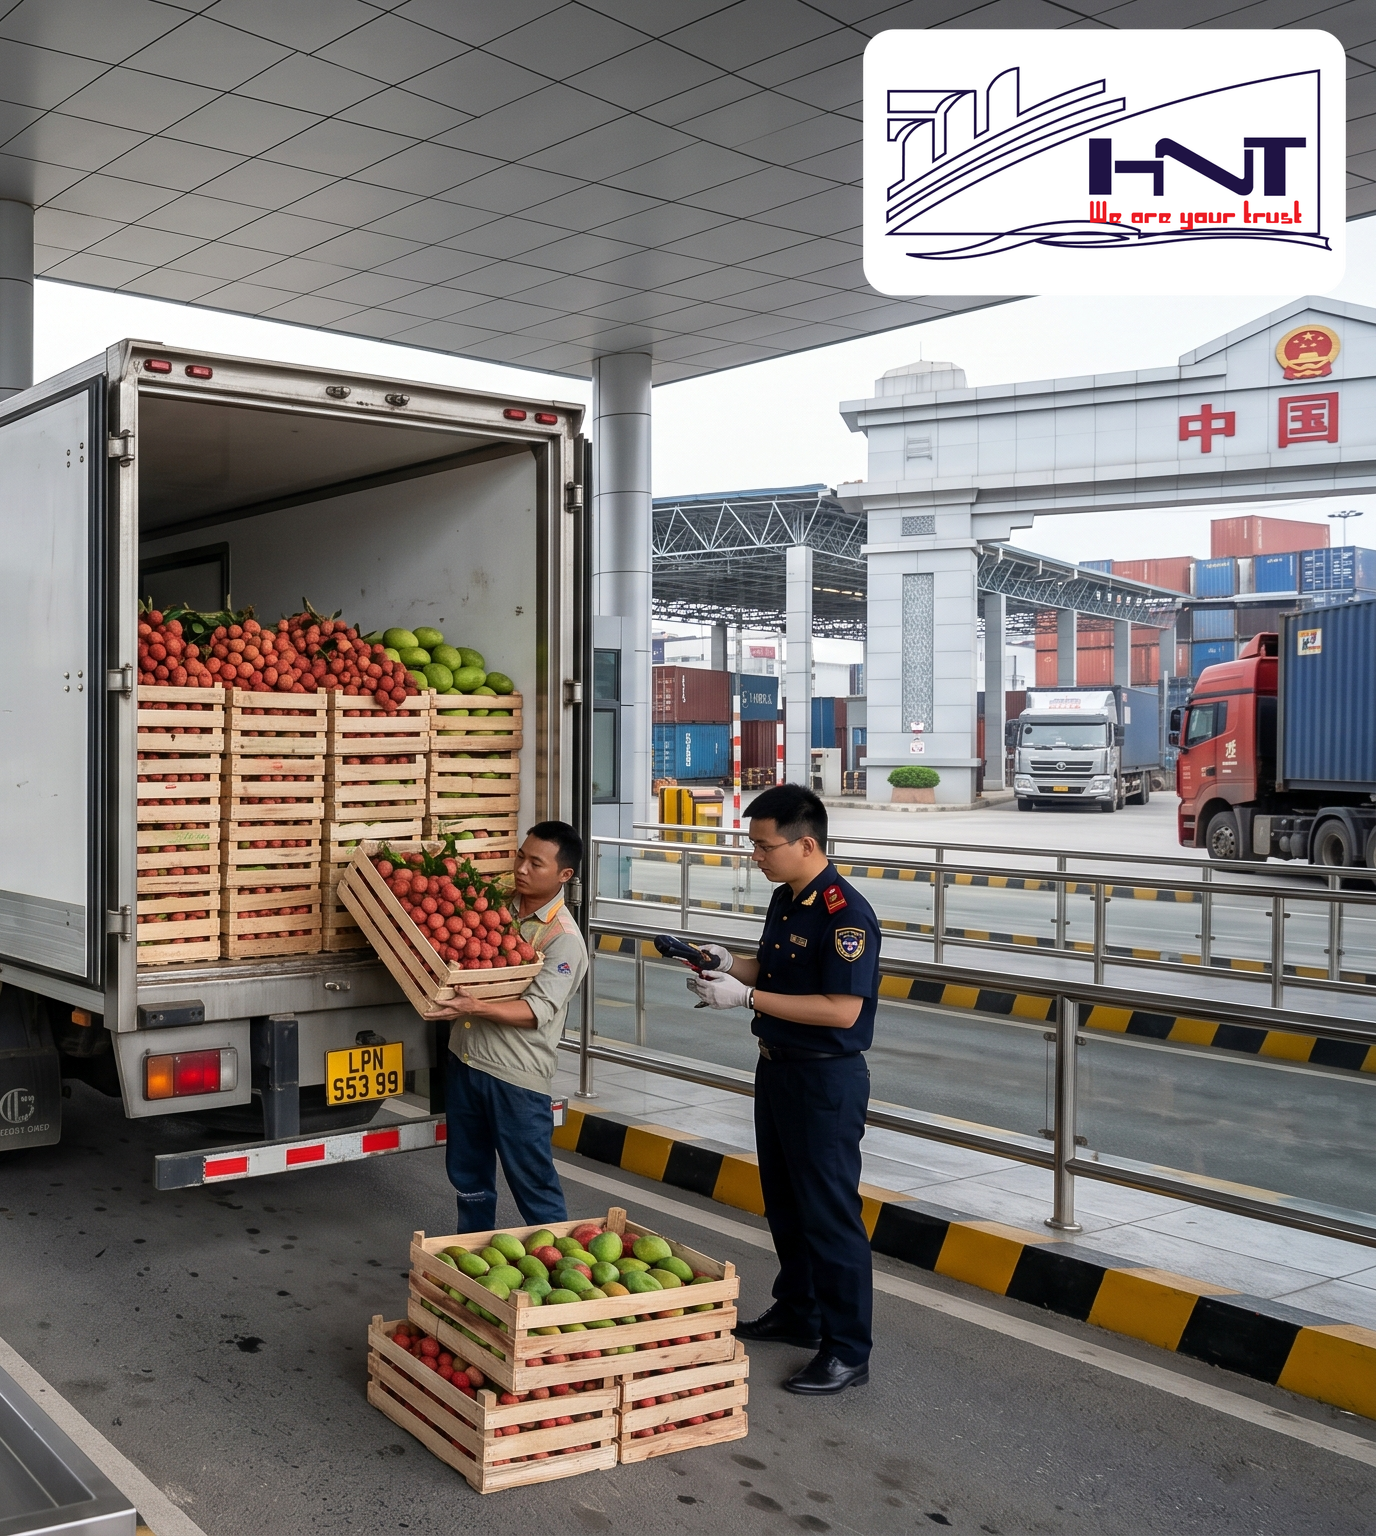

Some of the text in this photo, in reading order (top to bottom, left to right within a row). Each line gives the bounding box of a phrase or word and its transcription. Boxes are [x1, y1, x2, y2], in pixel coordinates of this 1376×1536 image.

[1179, 391, 1339, 453] 中国
[349, 1047, 383, 1073] LPN
[333, 1070, 398, 1101] S53 99
